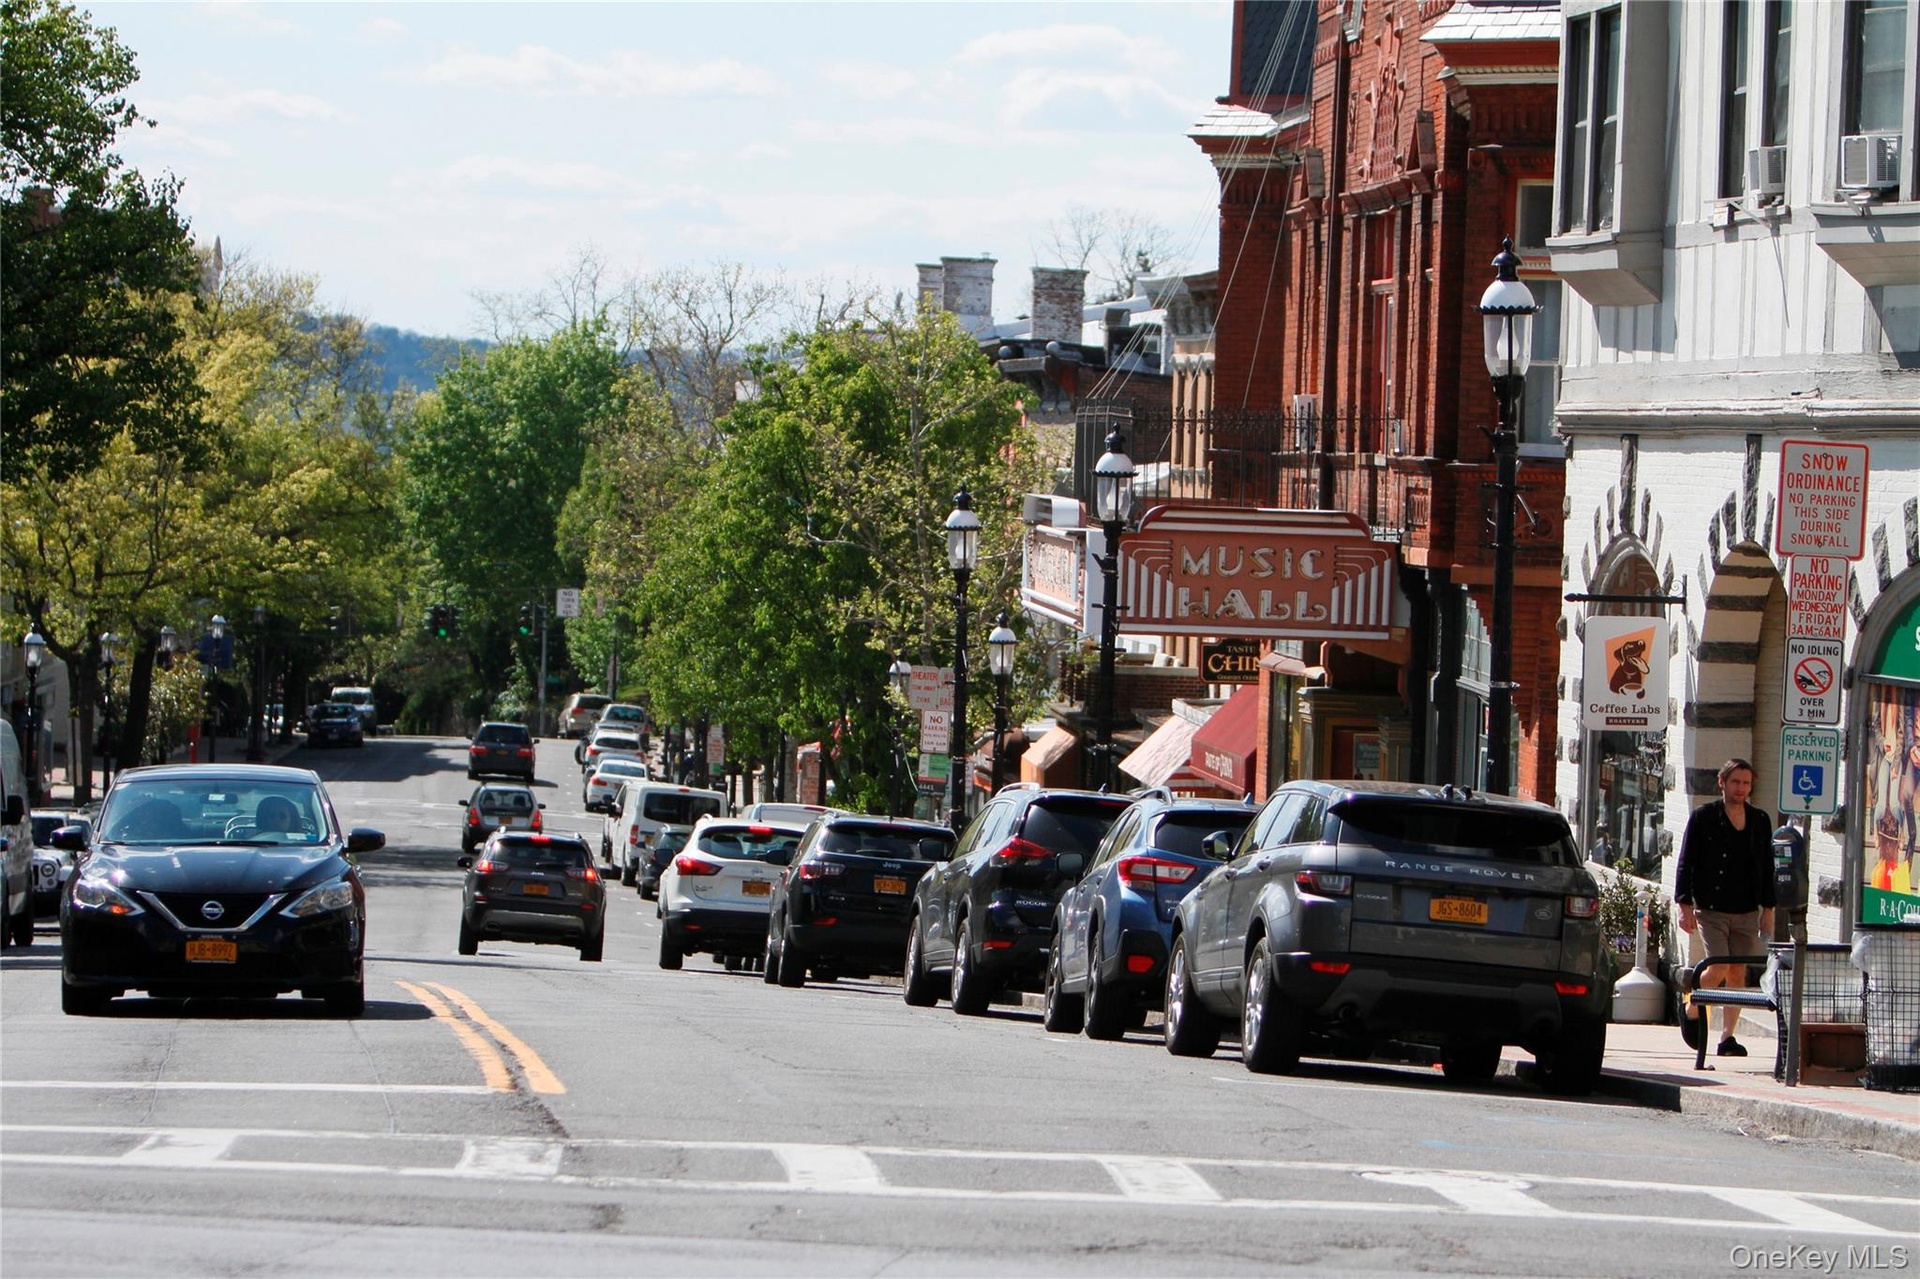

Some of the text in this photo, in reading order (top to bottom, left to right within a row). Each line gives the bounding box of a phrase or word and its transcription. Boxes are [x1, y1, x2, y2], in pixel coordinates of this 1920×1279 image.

[1801, 453, 1848, 471] SNOW
[1787, 473, 1860, 492] ORDINANCE
[1789, 493, 1856, 507] NO PARKING
[1794, 506, 1850, 520] THIS SIDE
[1800, 520, 1841, 533] DURING
[1791, 534, 1849, 548] SNOWFALL
[1180, 545, 1325, 580] MUSIC
[1811, 558, 1829, 574] NO
[1794, 574, 1842, 591] PARKING
[1797, 590, 1837, 602] MONDAY
[1177, 586, 1328, 621] HALL
[1791, 602, 1845, 614] WEDNESDAY
[1798, 613, 1839, 625] FRIDAY
[1791, 626, 1841, 637] 3AM-6AM
[1226, 645, 1256, 653] TASTE
[1791, 644, 1839, 656] NO IDLING
[911, 672, 938, 681] THEATER
[1800, 697, 1824, 707] OVER
[1589, 704, 1661, 714] Coffee Labs
[1798, 708, 1826, 718] 3 MIN
[930, 716, 942, 724] NO
[1785, 734, 1836, 748] RESERVED
[1788, 750, 1832, 762] PARKING
[882, 861, 901, 869] Jeep
[1385, 860, 1536, 882] RANGE ROVER
